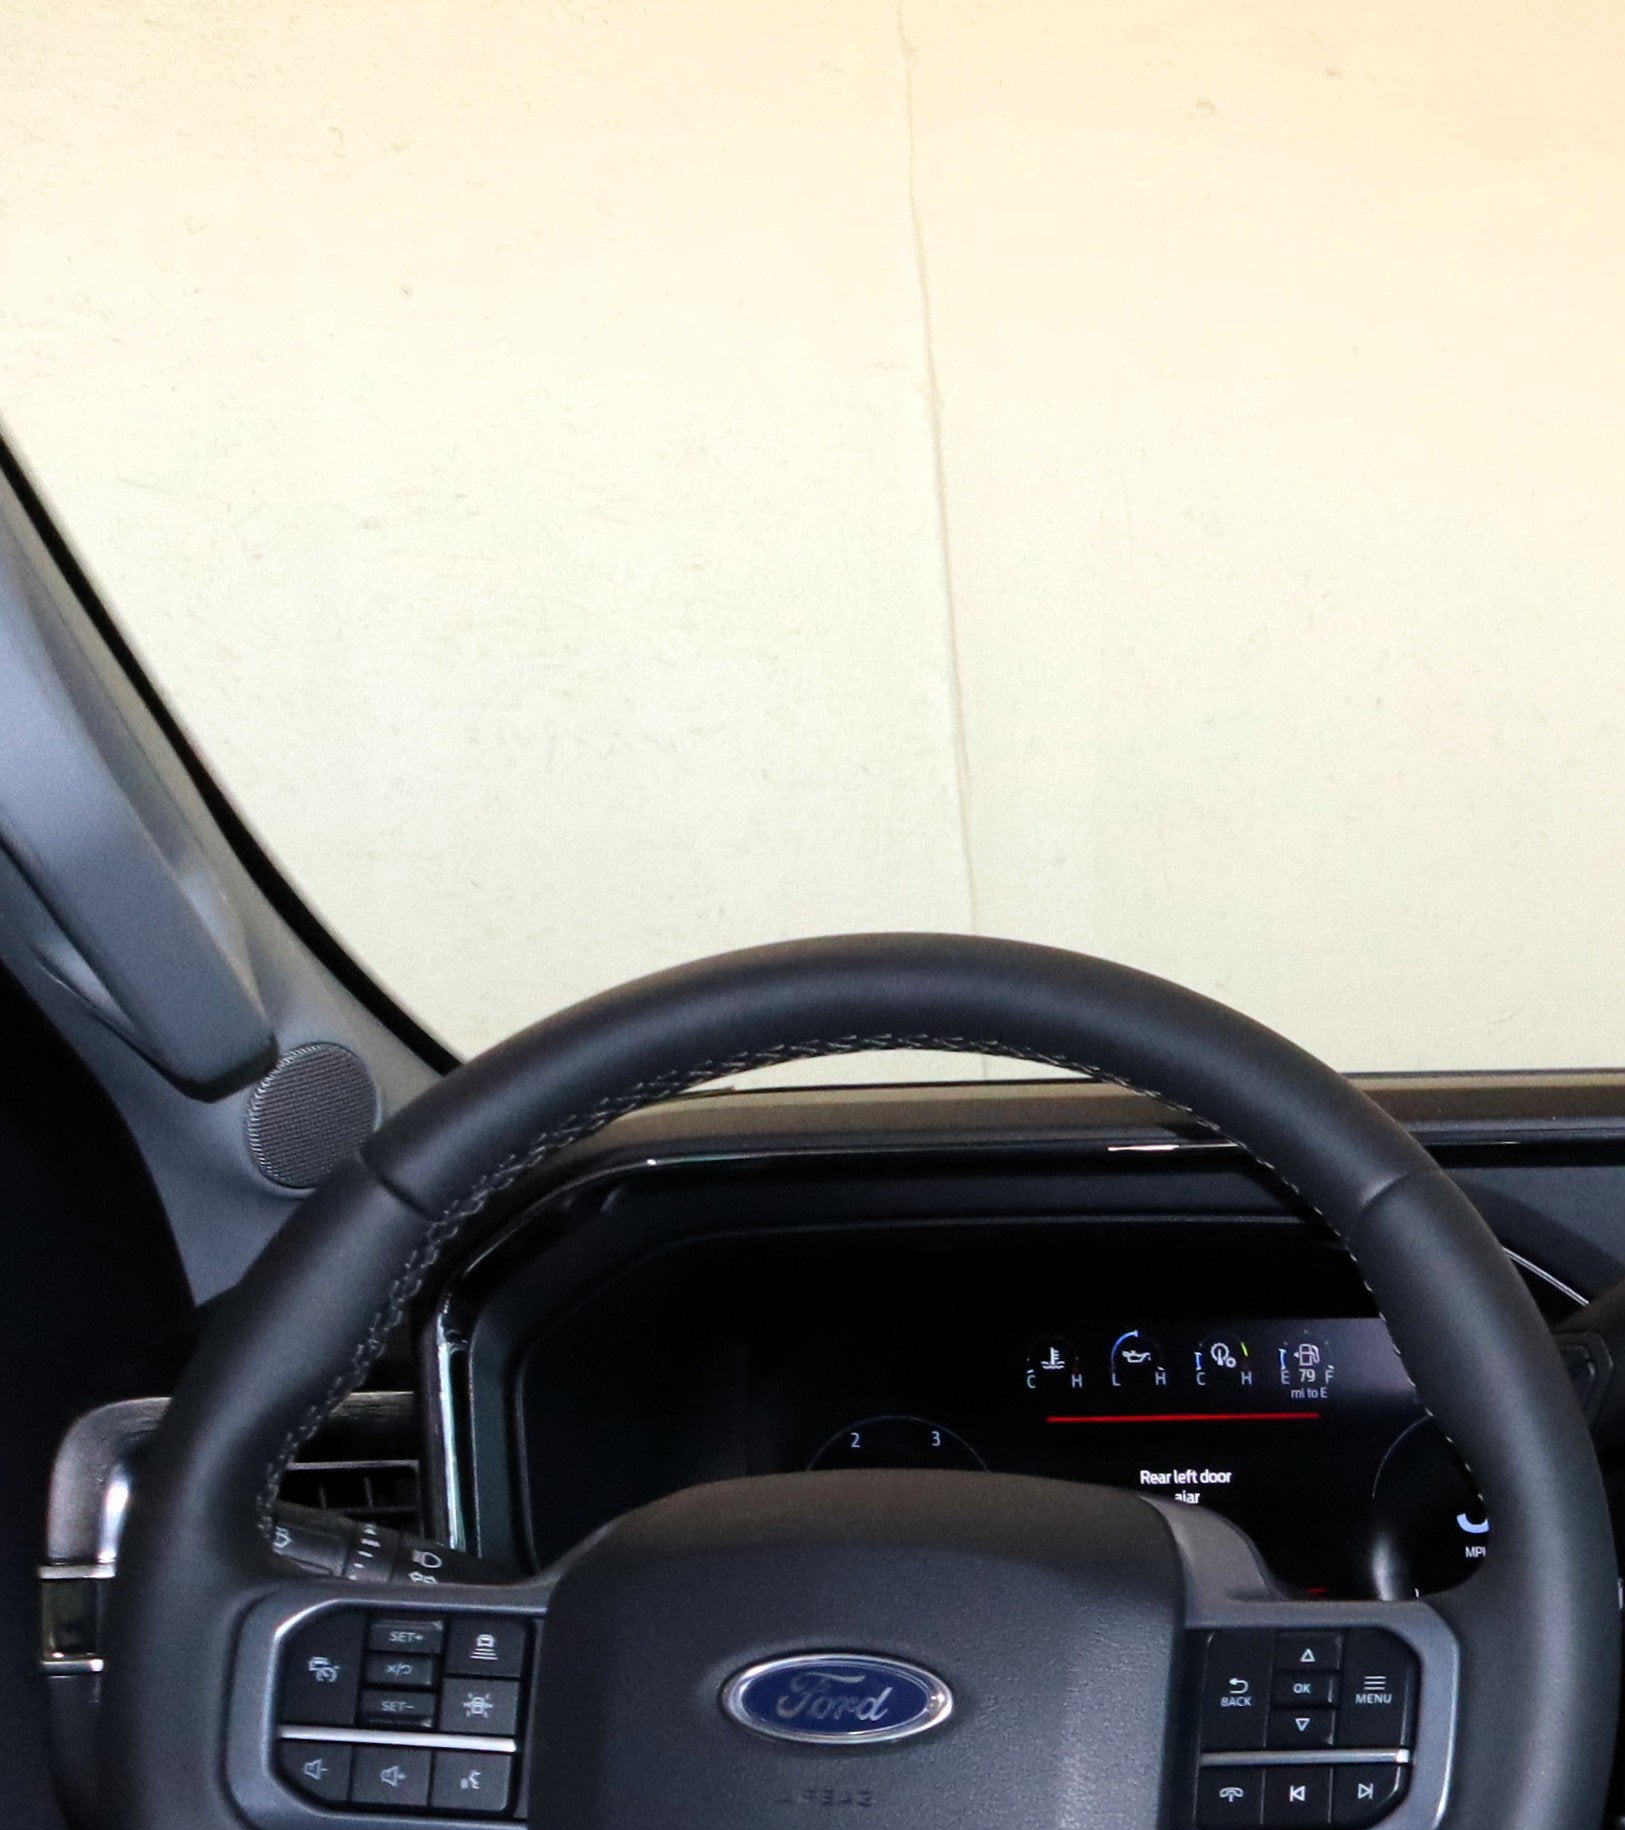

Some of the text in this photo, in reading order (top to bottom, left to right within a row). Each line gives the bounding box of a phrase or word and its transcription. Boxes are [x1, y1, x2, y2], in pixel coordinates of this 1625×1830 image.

[1071, 1373, 1082, 1387] H
[1112, 1372, 1167, 1386] L H
[1196, 1371, 1252, 1385] C H
[1281, 1369, 1334, 1384] E 79 F
[1307, 1387, 1319, 1398] to
[1320, 1387, 1328, 1398] E
[850, 1432, 860, 1448] 2
[931, 1431, 941, 1447] 3
[1139, 1469, 1232, 1485] Rear left door
[1293, 1683, 1311, 1694] OK
[776, 1671, 893, 1722] Ford
[1220, 1696, 1252, 1708] BACK
[1355, 1693, 1392, 1705] MENU
